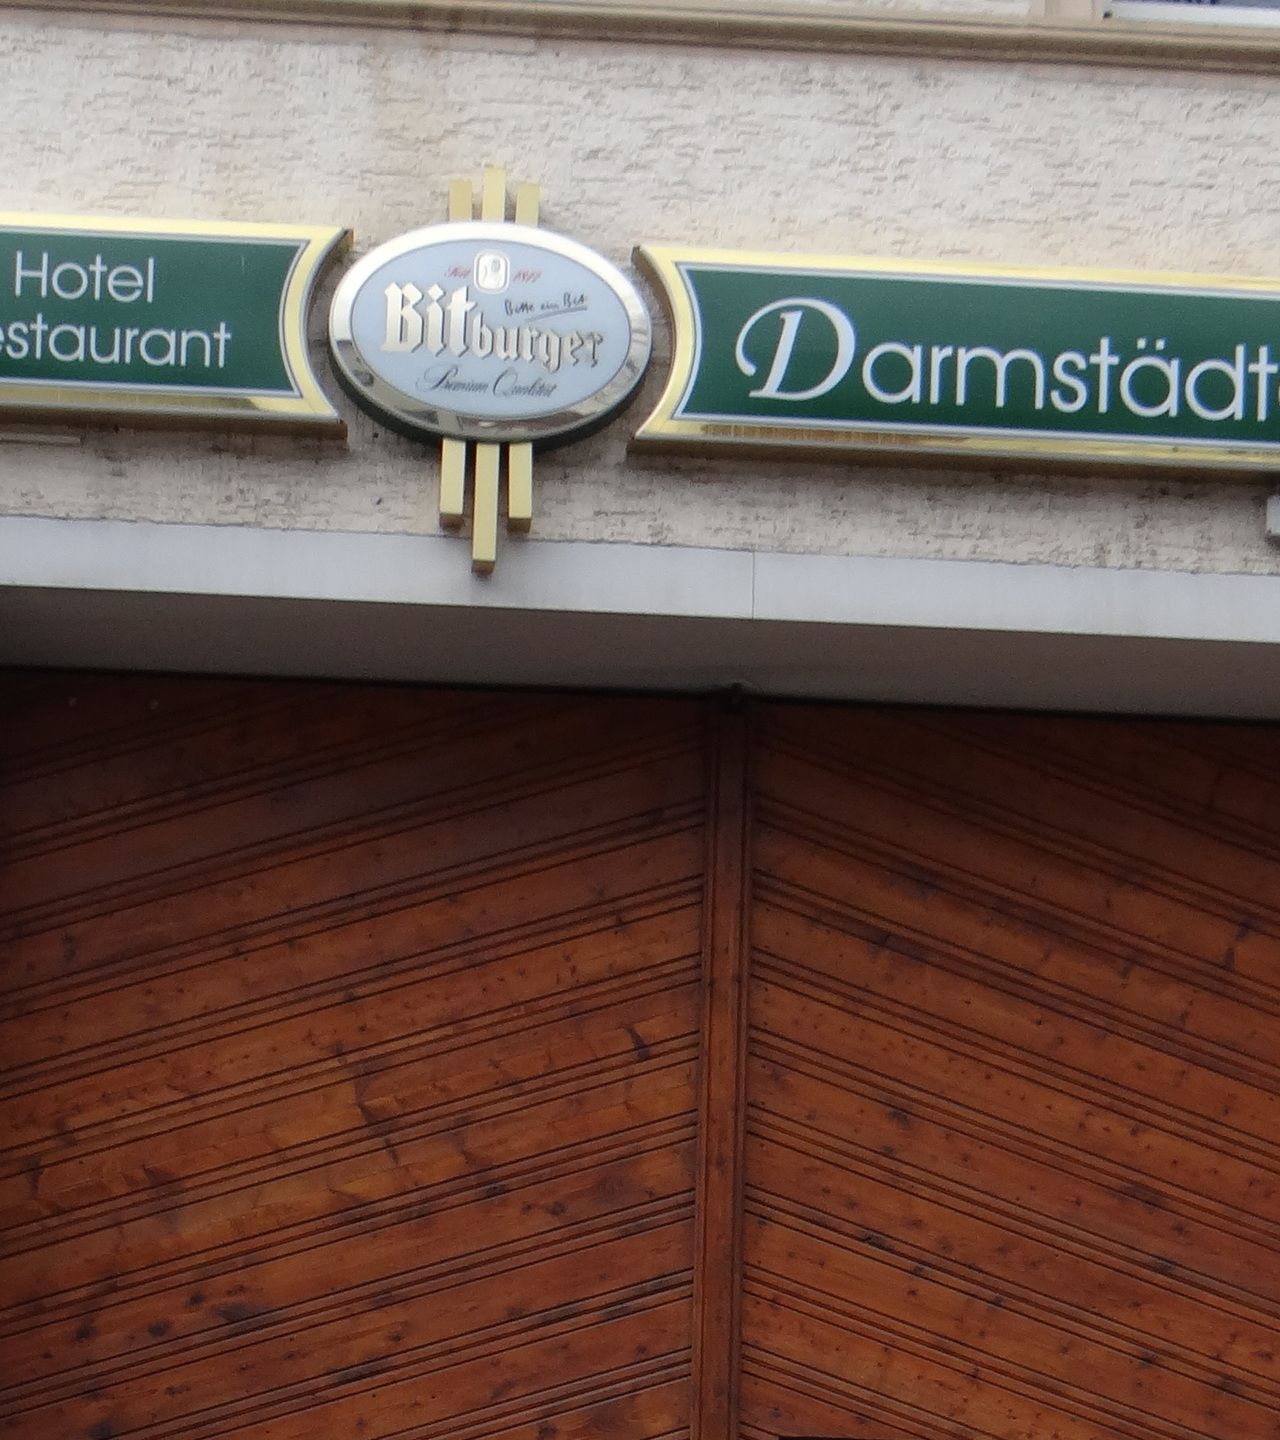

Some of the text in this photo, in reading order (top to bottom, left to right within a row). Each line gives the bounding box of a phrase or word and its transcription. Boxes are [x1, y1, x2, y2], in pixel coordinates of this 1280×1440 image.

[14, 249, 155, 303] Hotel
[380, 281, 604, 374] Bitburger
[416, 363, 489, 393] Premium
